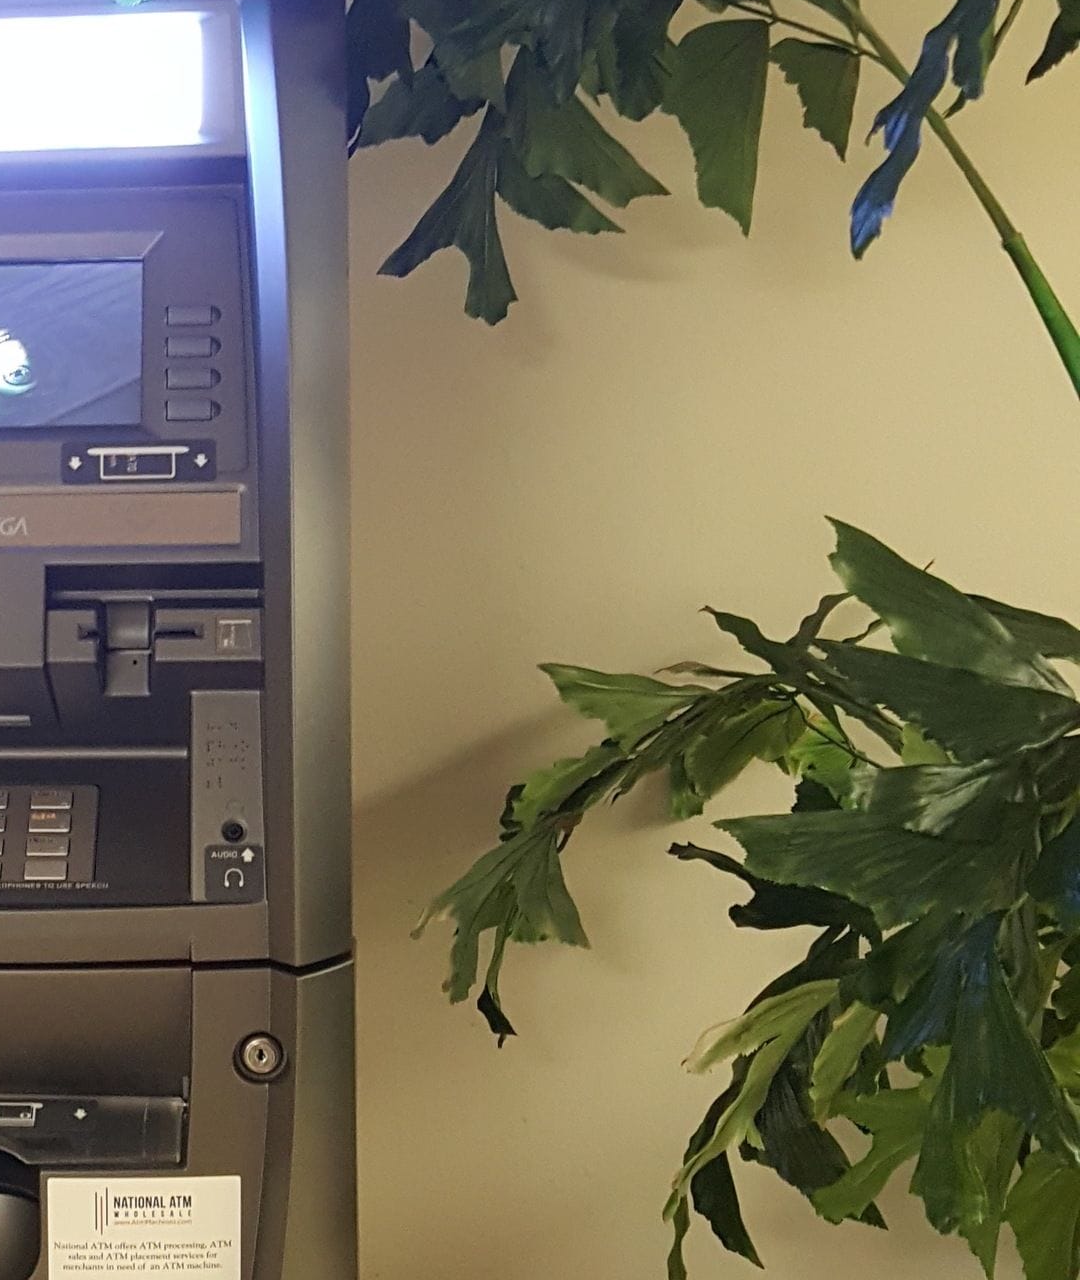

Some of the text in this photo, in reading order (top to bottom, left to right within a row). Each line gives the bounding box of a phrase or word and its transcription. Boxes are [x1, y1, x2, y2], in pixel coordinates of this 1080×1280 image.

[114, 1195, 191, 1209] NATIONAL ATM
[54, 1242, 88, 1250] National
[90, 1242, 112, 1250] ATM
[115, 1242, 137, 1250] offers
[164, 1241, 208, 1251] processing,
[209, 1240, 232, 1248] ATM
[89, 1252, 104, 1260] and
[106, 1252, 128, 1260] ATM
[130, 1252, 170, 1261] placement
[206, 1251, 218, 1259] for
[63, 1262, 104, 1270] merchants
[117, 1262, 135, 1270] need
[138, 1262, 146, 1270] of
[163, 1262, 185, 1270] ATM
